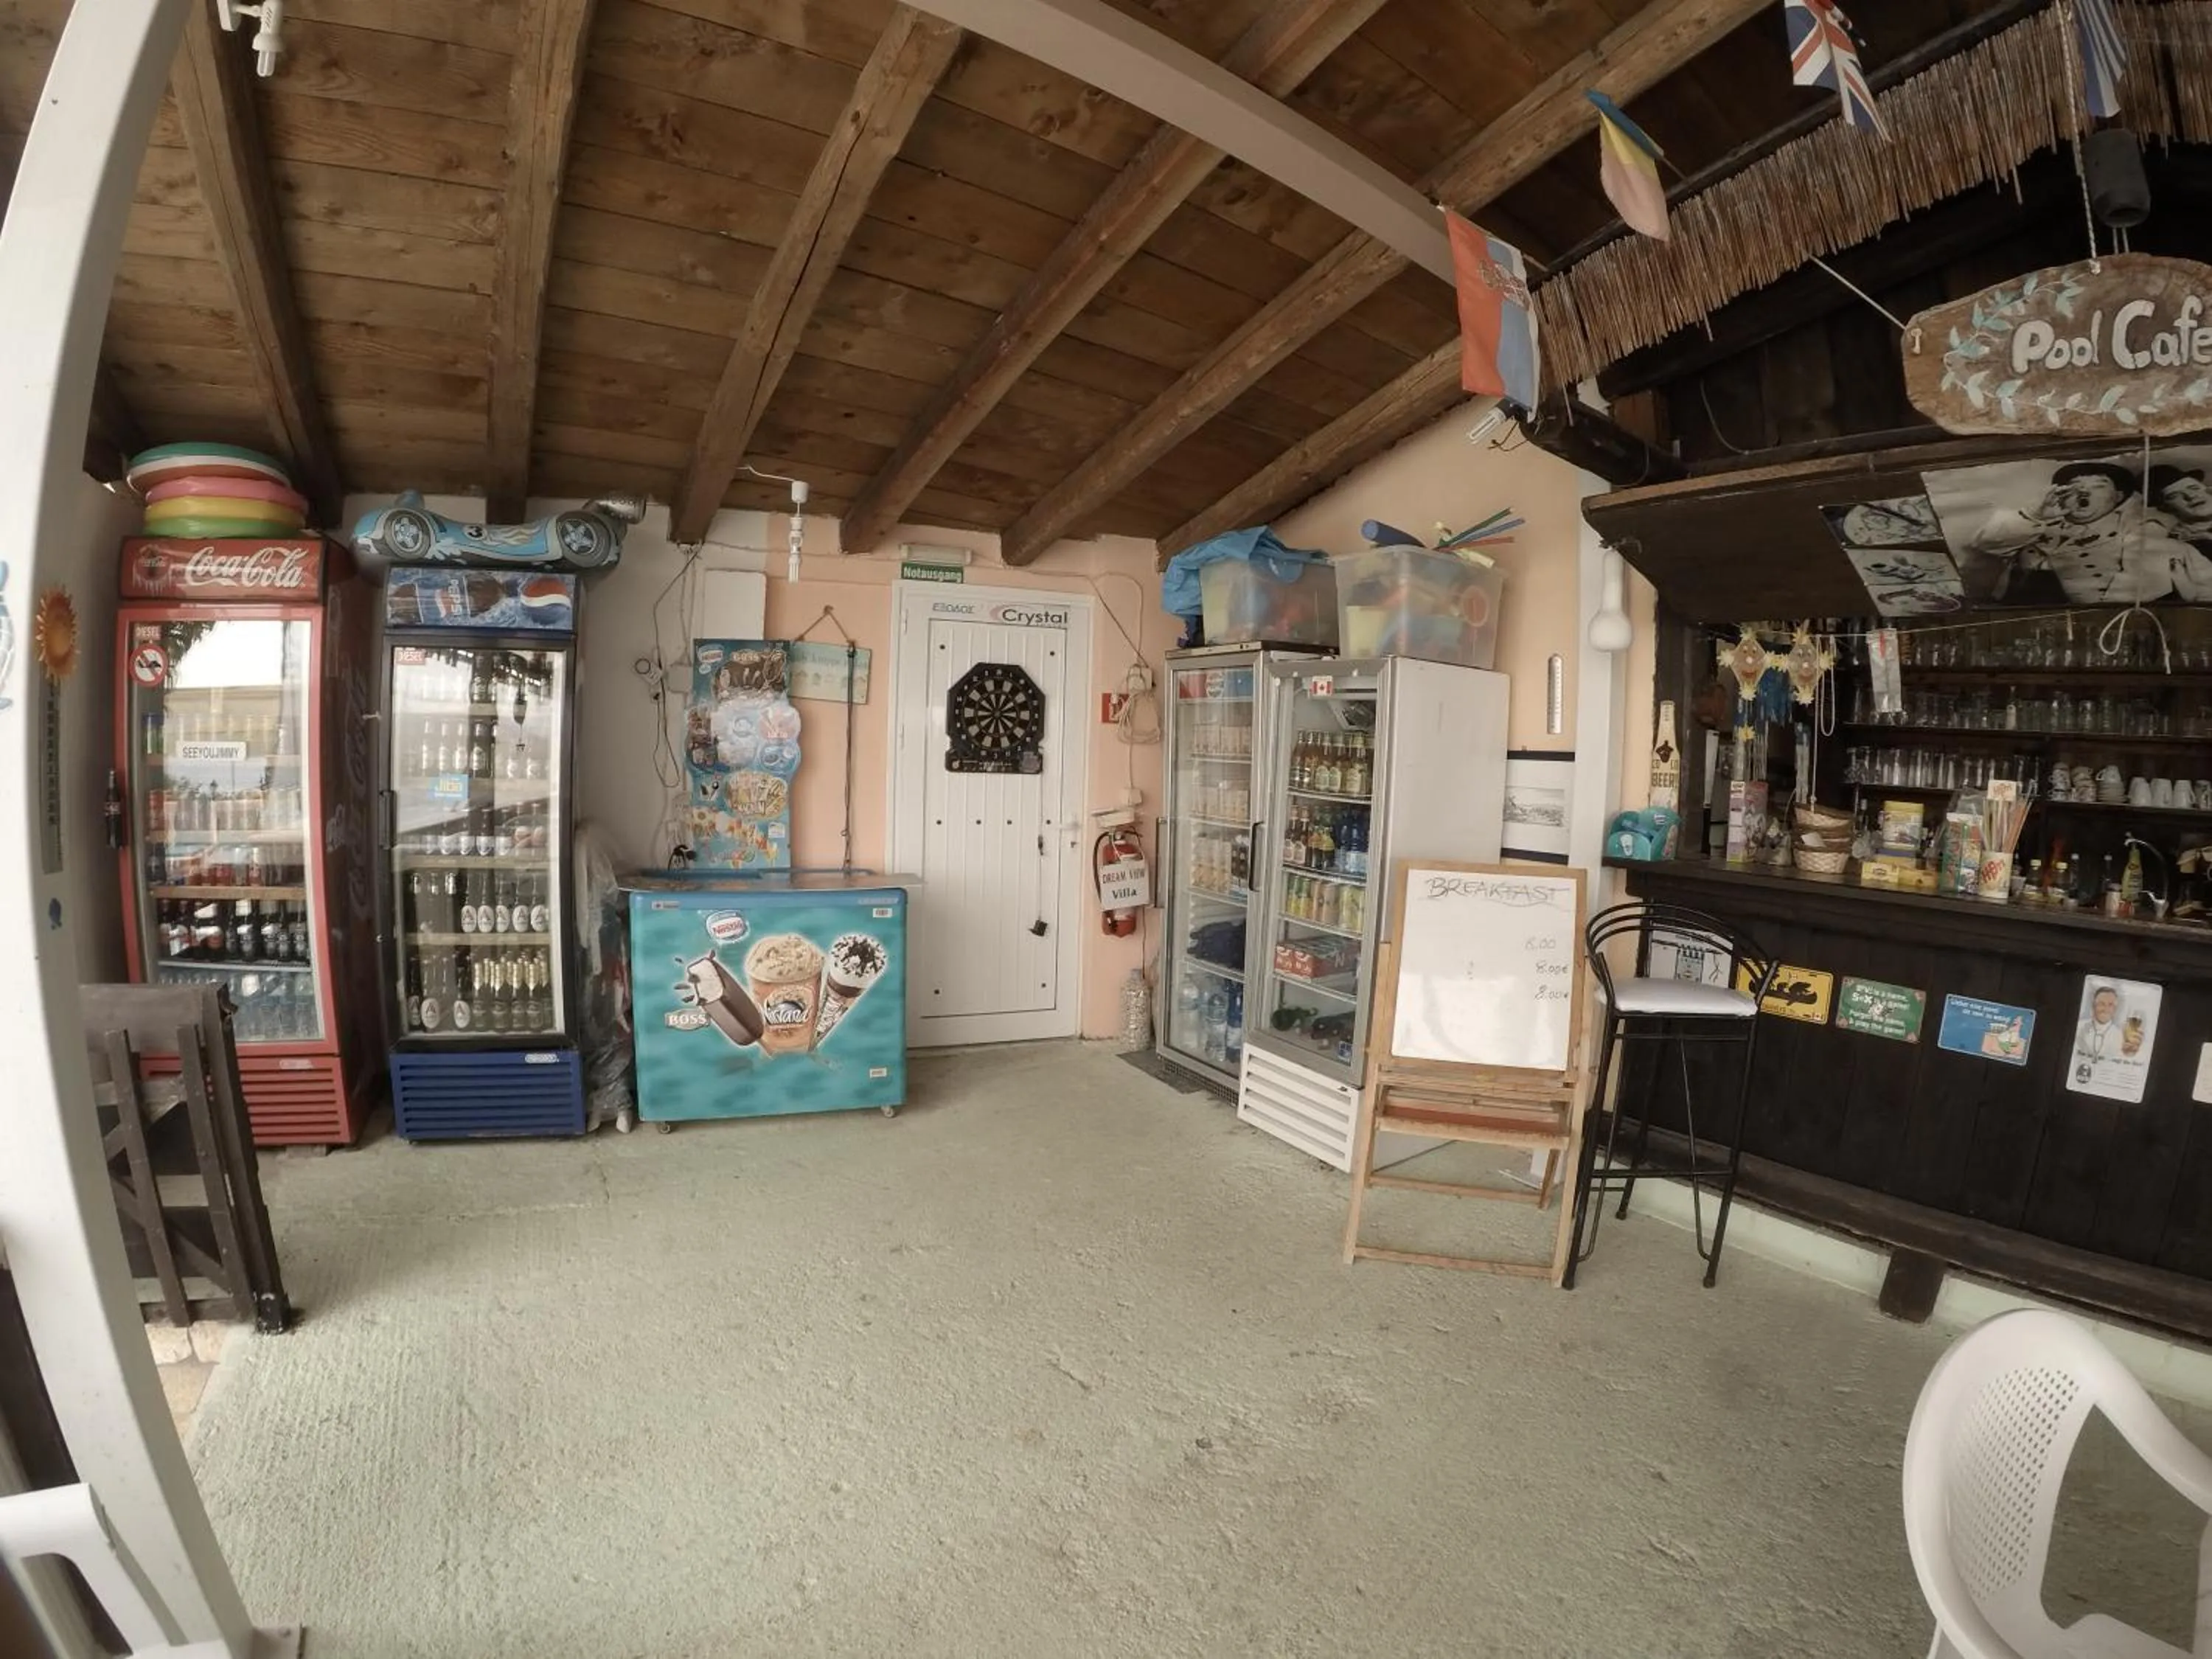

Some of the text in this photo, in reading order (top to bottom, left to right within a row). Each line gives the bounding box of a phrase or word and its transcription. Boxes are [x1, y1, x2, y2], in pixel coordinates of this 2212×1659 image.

[2012, 295, 2212, 373] Pool Cafe
[185, 546, 308, 588] Coca-Cola
[903, 566, 962, 582] Notausgang
[1001, 608, 1068, 626] Crystal
[1102, 871, 1126, 884] DREAM
[1112, 888, 1138, 900] Villa
[1425, 877, 1571, 901] BREAKFAST
[668, 1013, 708, 1026] BOSS
